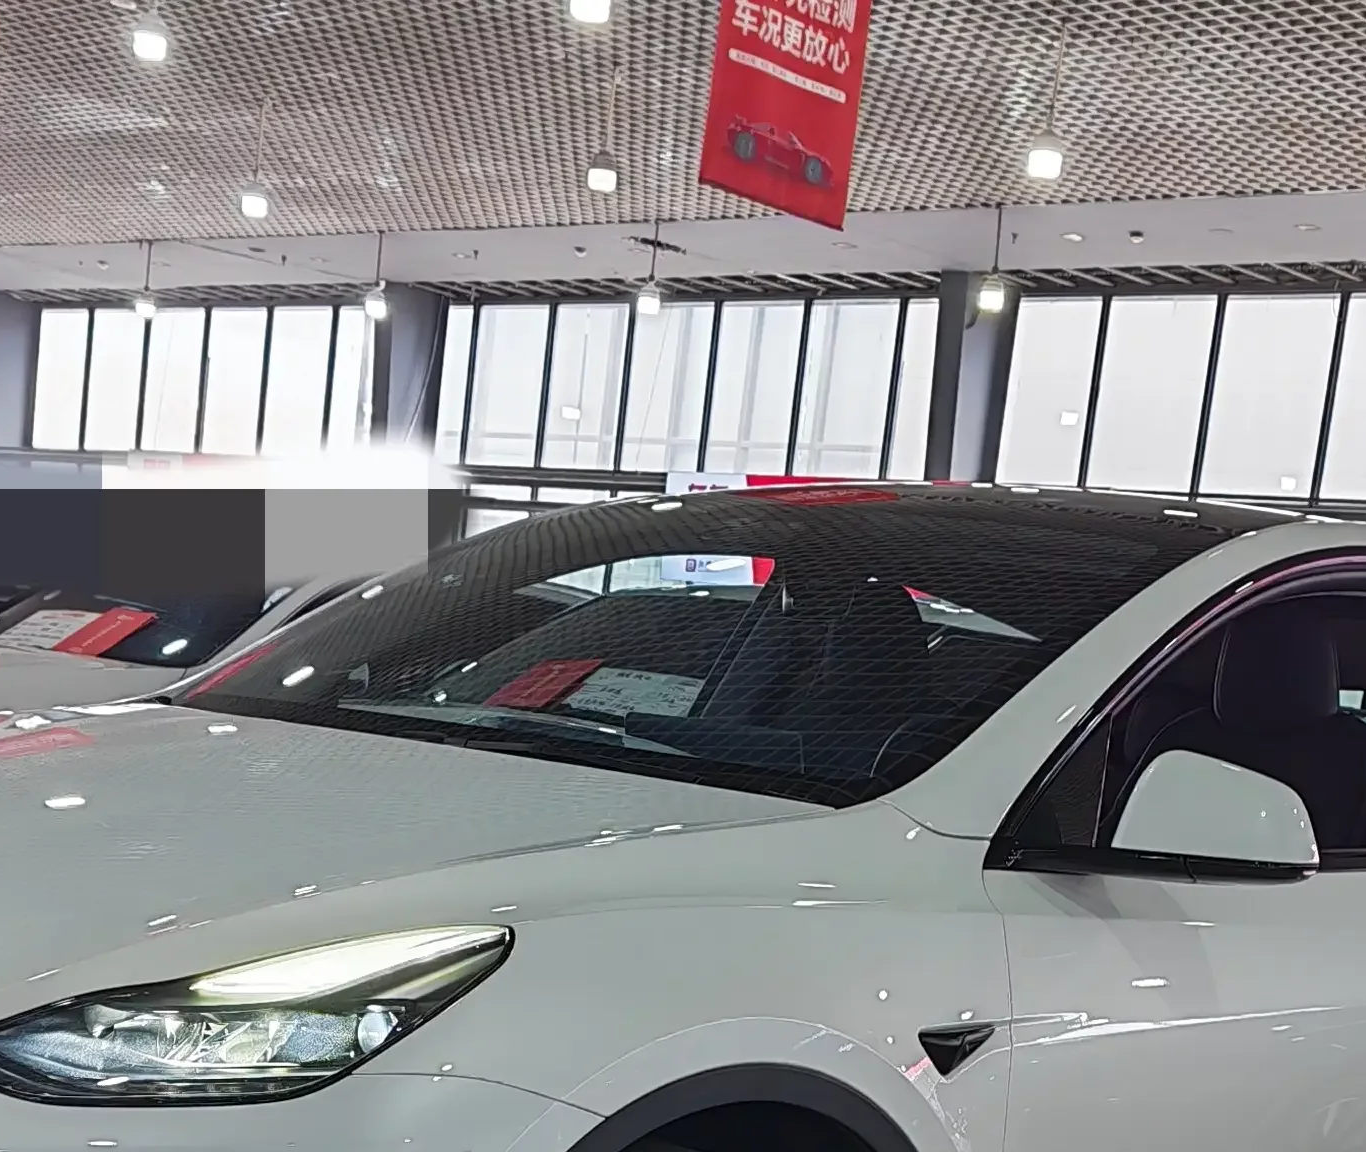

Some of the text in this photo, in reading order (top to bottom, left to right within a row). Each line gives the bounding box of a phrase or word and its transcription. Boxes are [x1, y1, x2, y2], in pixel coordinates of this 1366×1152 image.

[731, 0, 851, 75] 车况更放心
